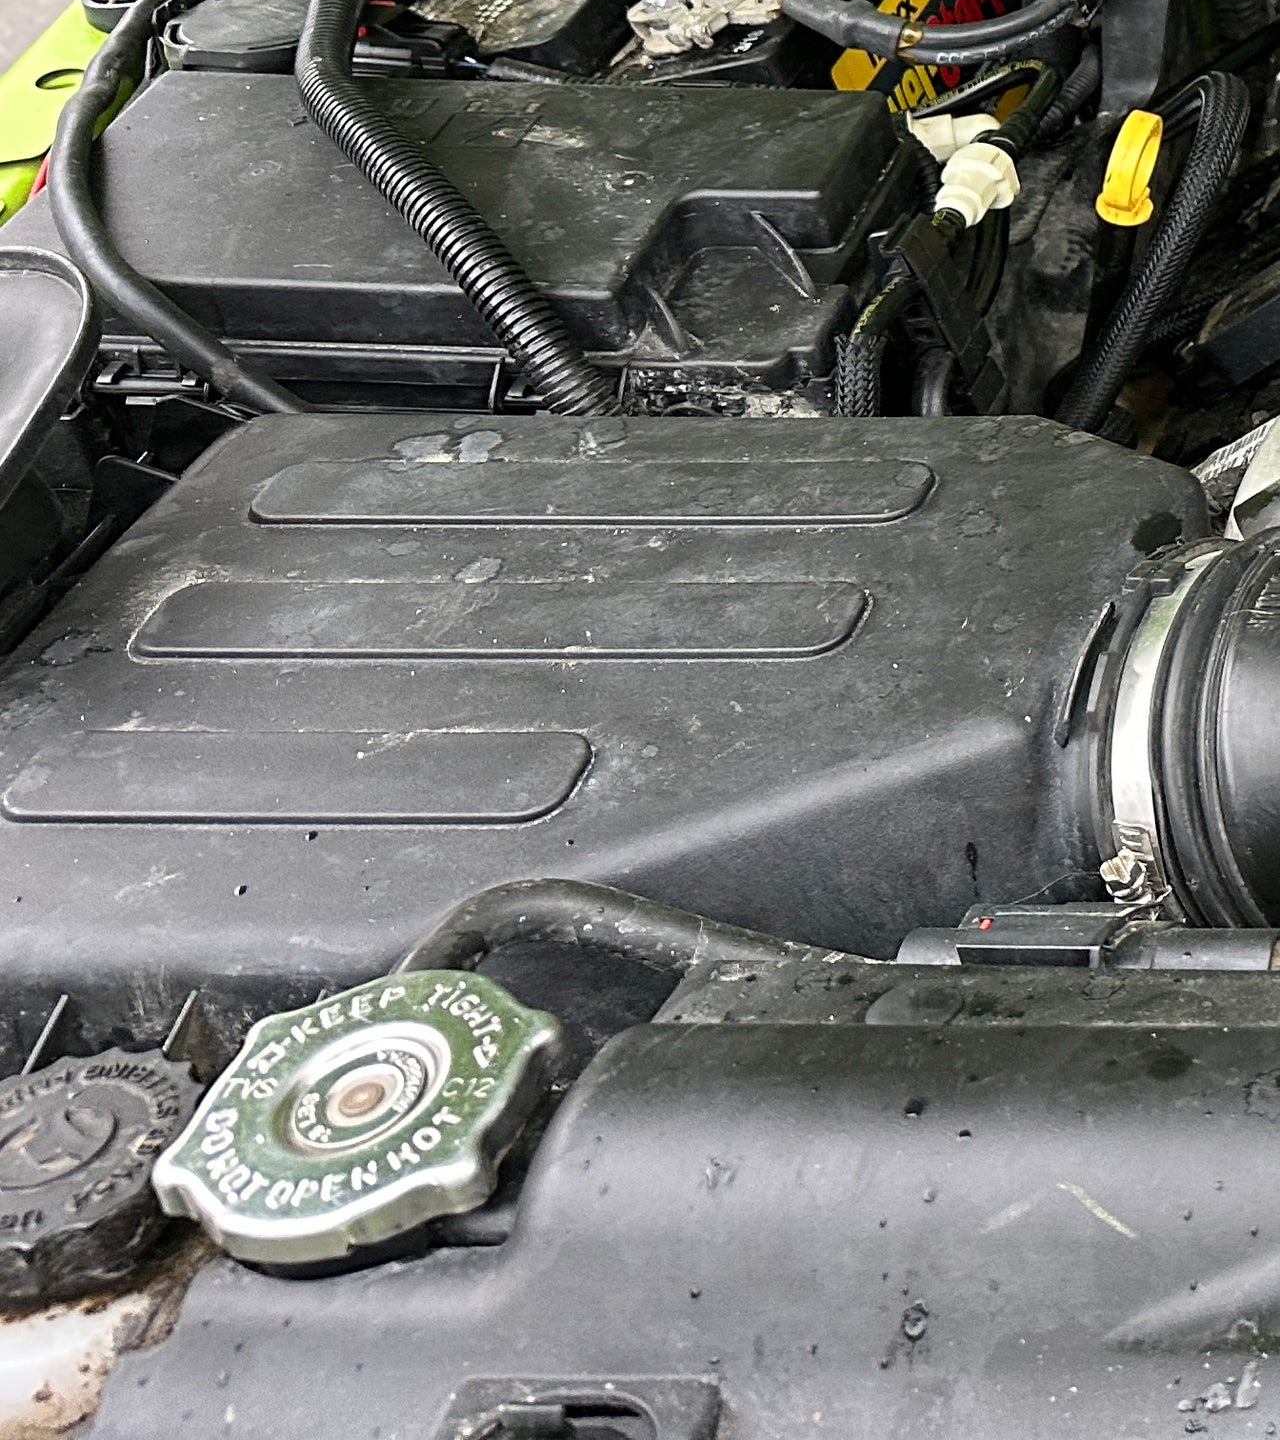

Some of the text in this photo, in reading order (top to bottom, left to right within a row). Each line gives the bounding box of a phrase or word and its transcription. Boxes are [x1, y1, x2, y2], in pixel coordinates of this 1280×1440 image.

[221, 1076, 279, 1101] TVS
[441, 1076, 499, 1099] C12
[264, 1160, 379, 1211] OPEN
[386, 1105, 463, 1172] HOT
